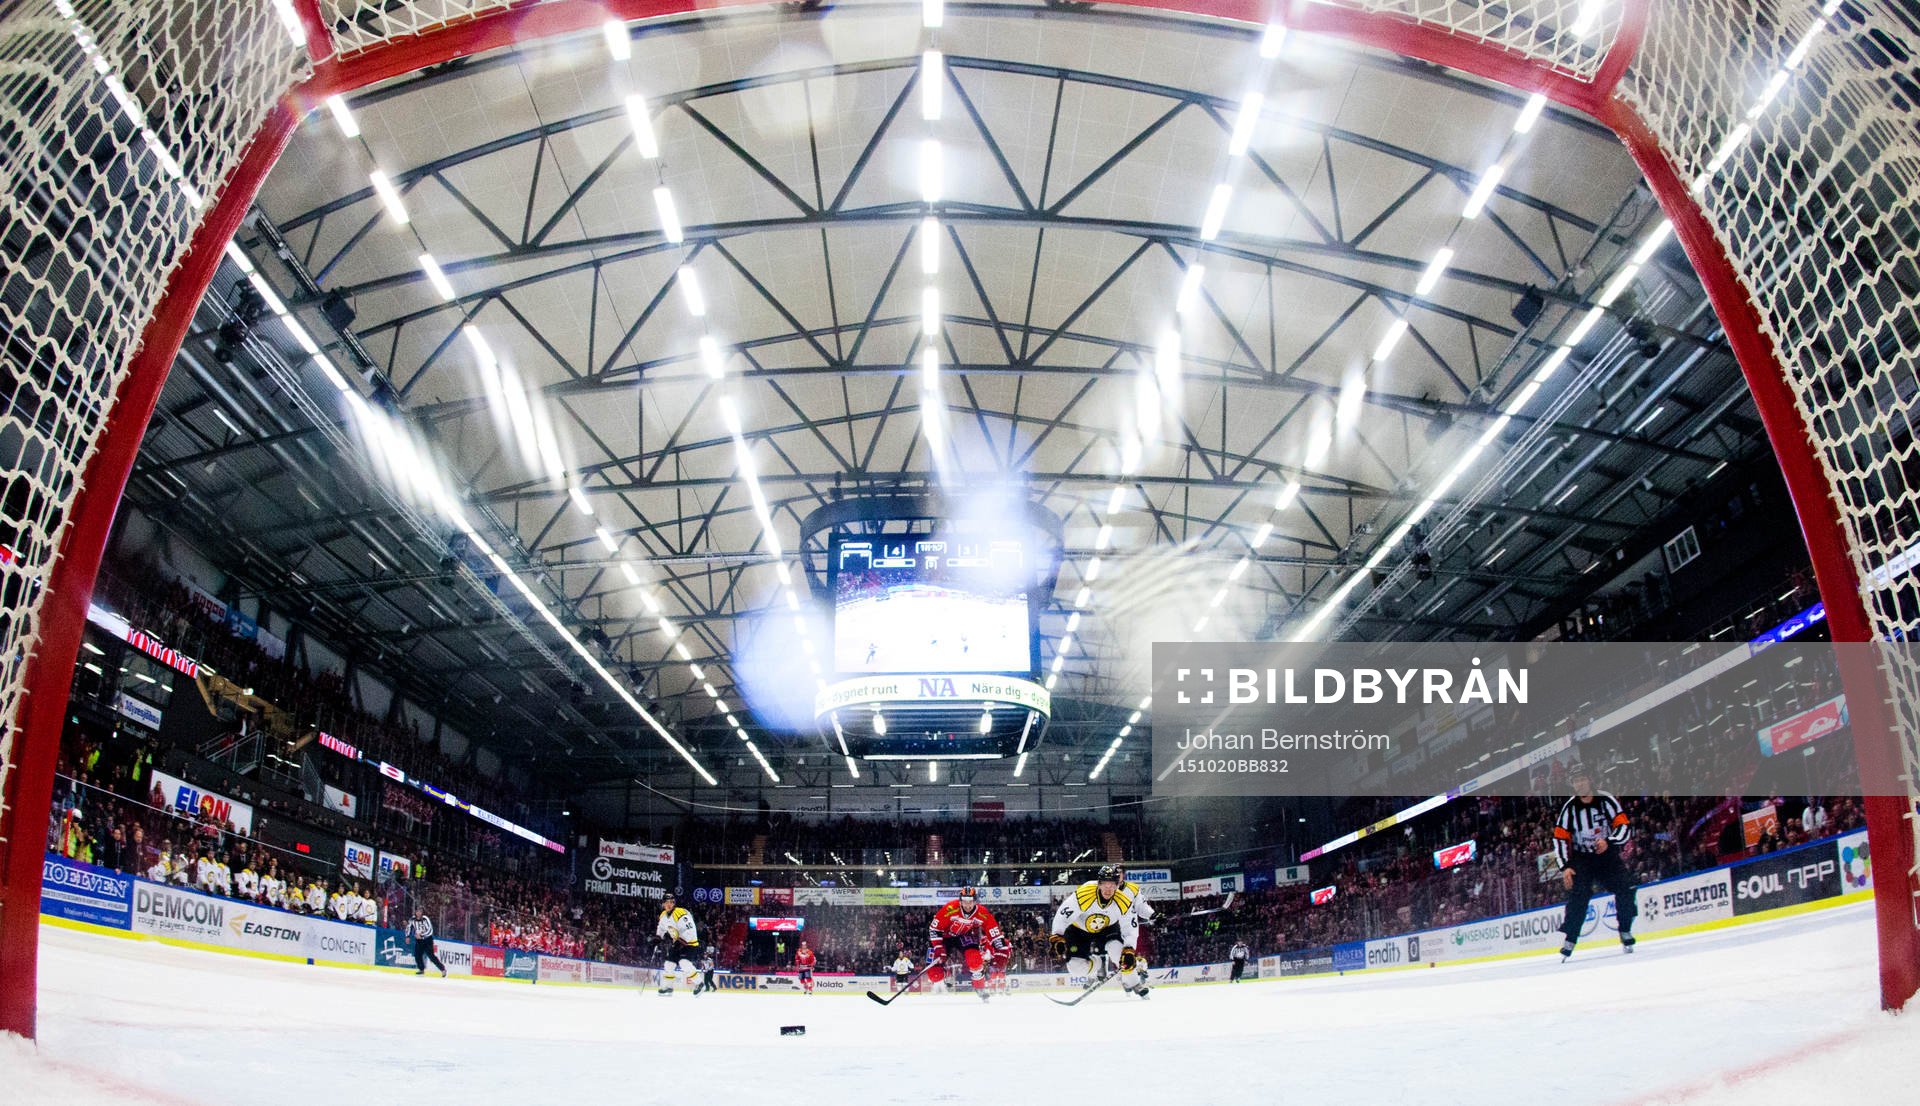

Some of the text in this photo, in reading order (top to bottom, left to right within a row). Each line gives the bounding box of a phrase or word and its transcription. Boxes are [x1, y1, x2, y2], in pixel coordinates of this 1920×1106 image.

[872, 684, 898, 695] runt
[918, 678, 958, 698] NA
[972, 682, 1001, 693] Nära
[1005, 685, 1021, 699] dig
[175, 786, 230, 823] ELON
[348, 848, 371, 865] ELON
[592, 857, 662, 882] Gustavsvik
[44, 861, 126, 898] MOELVEN
[1664, 882, 1728, 909] PISCATOR
[137, 888, 224, 928] DEMCOM
[1664, 903, 1713, 917] ventilation
[160, 918, 184, 932] players
[243, 922, 301, 942] EASTON
[1504, 913, 1562, 940] DEMCOM
[321, 936, 367, 955] CONCENT
[440, 950, 471, 966] WÜRTH
[816, 981, 844, 989] Nolato
